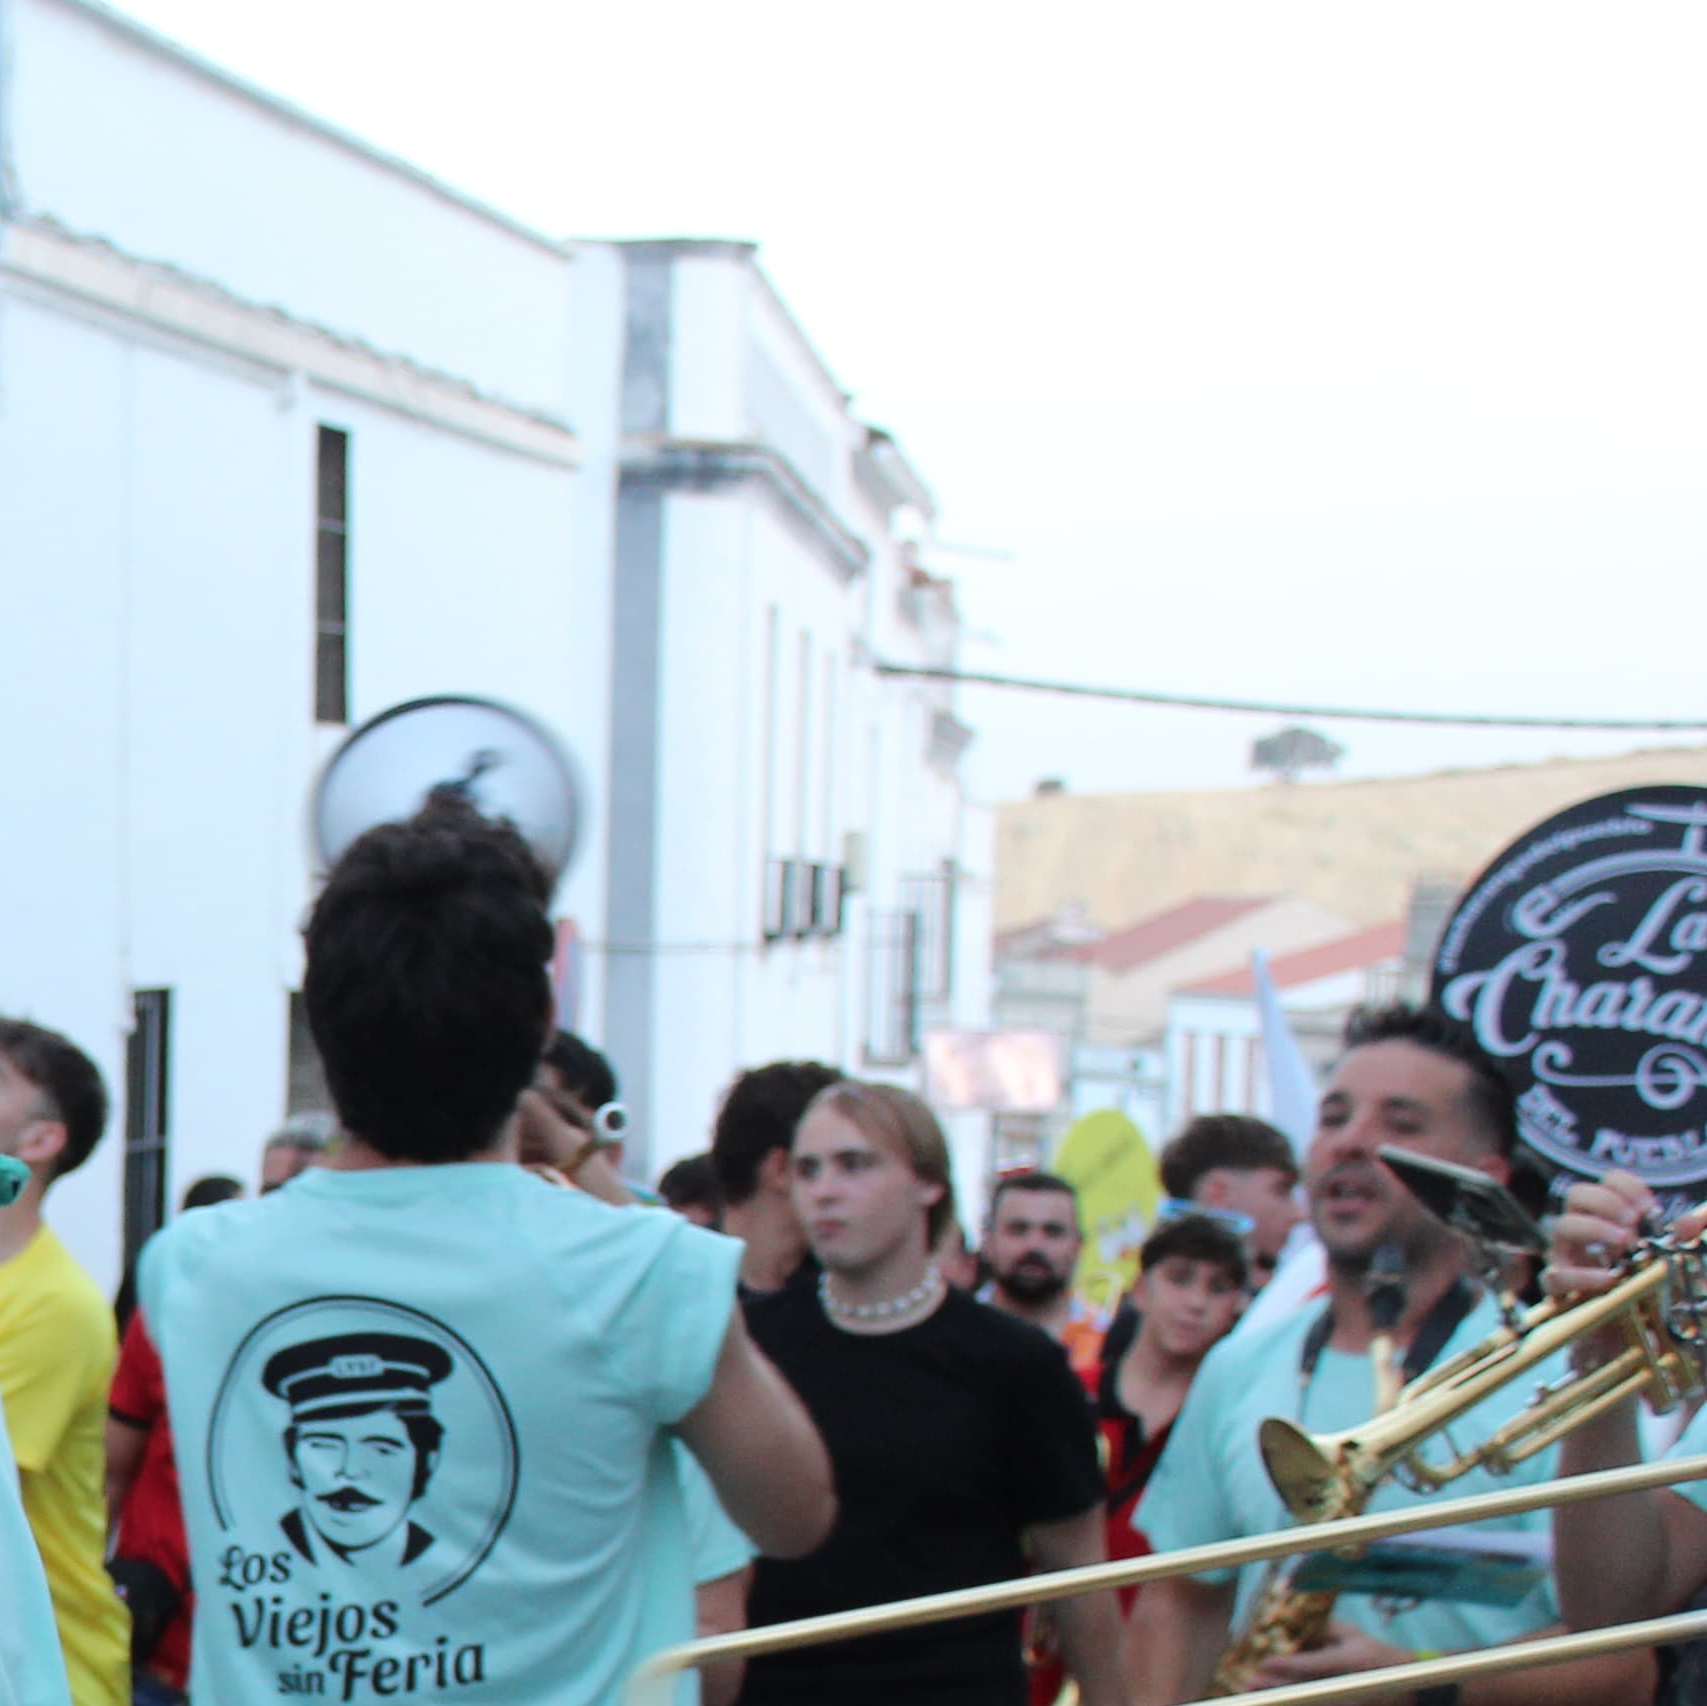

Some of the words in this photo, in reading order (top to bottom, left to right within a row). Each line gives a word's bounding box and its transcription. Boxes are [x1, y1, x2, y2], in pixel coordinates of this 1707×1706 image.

[219, 1545, 291, 1591] Los
[231, 1592, 400, 1658] Viejos
[277, 1664, 325, 1694] sin
[328, 1636, 486, 1702] Feria
